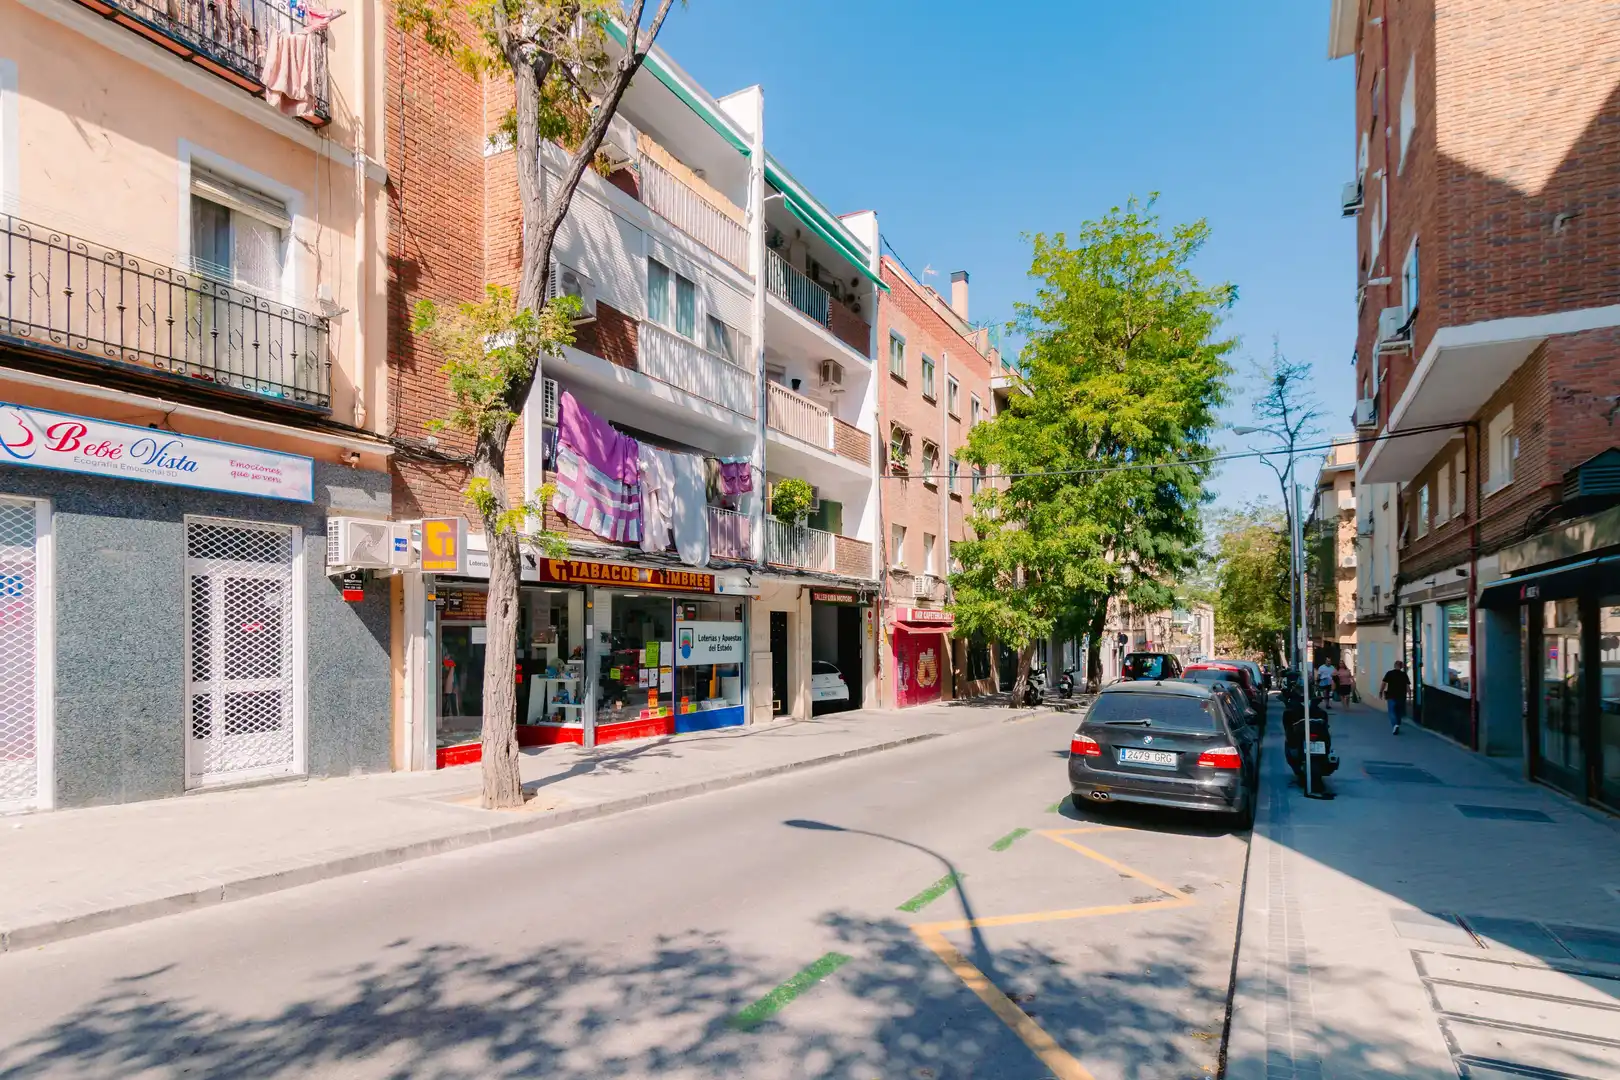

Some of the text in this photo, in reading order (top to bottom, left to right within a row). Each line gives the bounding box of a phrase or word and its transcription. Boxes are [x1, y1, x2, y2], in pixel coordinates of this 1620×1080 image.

[44, 421, 200, 473] Bebé Vista
[120, 463, 165, 476] Emocional
[230, 470, 250, 479] que
[570, 561, 640, 583] TABACOS
[721, 633, 742, 643] Apuestas
[708, 644, 733, 652] del Estado
[1127, 751, 1172, 763] 2479 GRG
